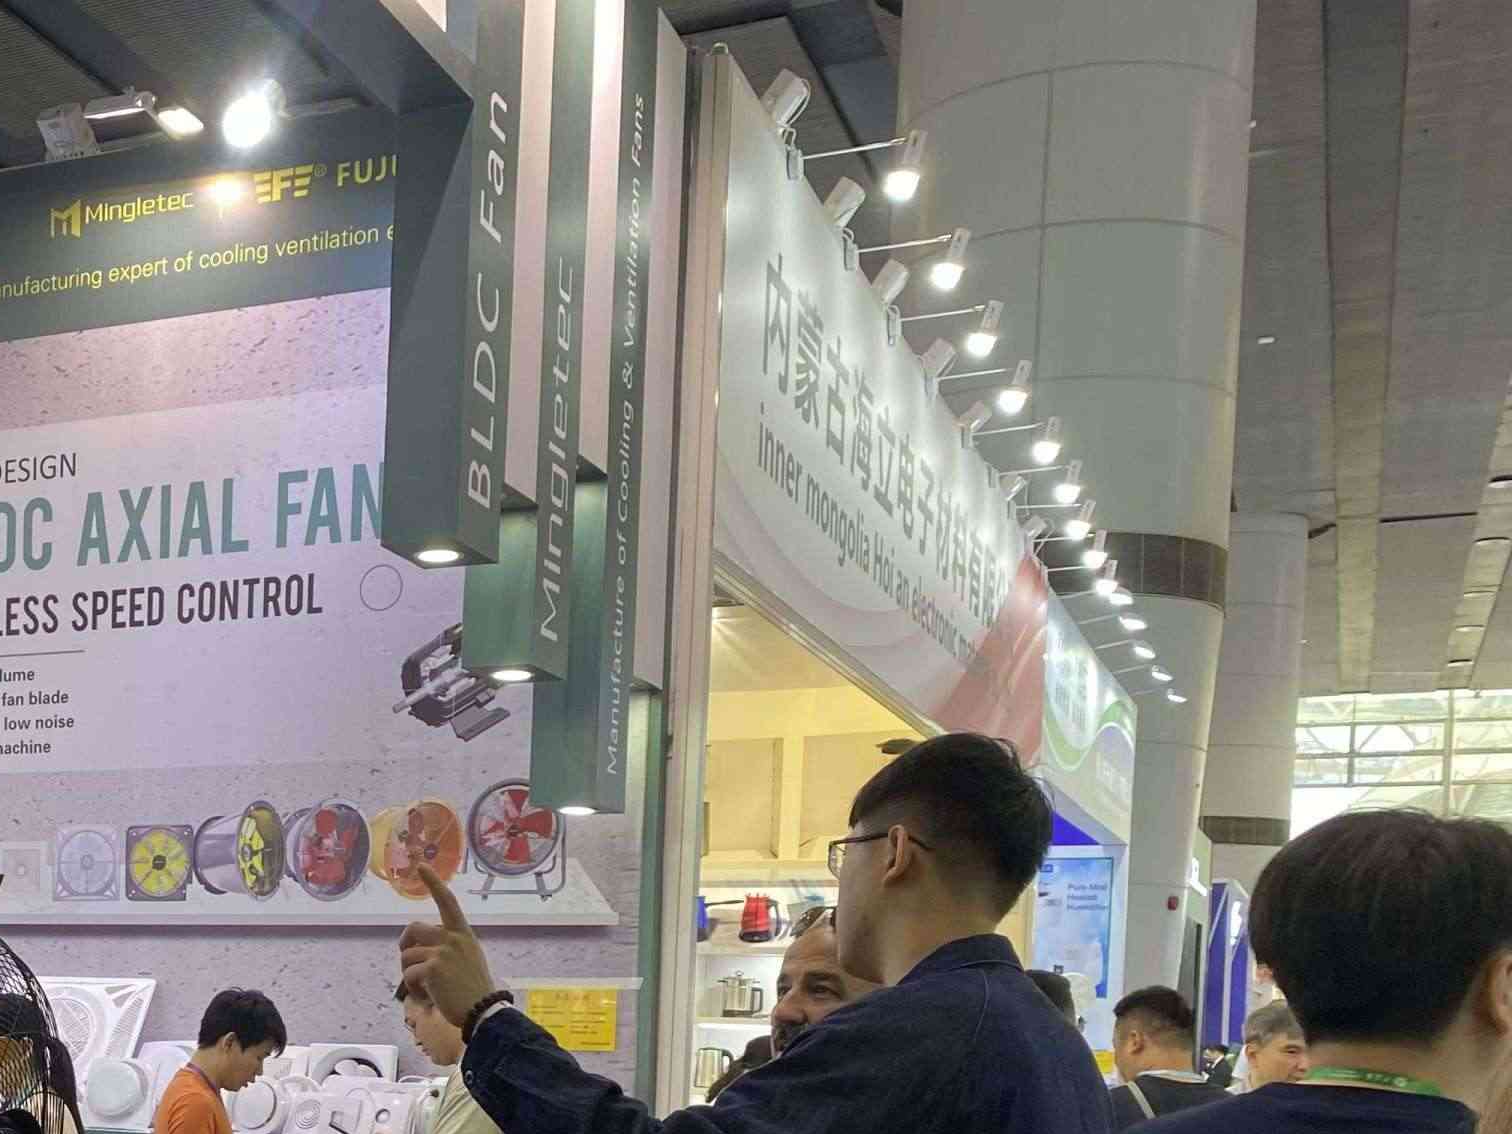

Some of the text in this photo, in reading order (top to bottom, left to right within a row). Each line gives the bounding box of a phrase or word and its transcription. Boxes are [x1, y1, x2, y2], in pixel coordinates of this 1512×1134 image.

[85, 191, 194, 224] Mingletec
[108, 258, 168, 283] expert
[174, 251, 194, 273] of
[199, 242, 268, 269] cooling
[275, 226, 379, 257] ventilation
[467, 90, 509, 510] BLDC Fan
[540, 256, 573, 642] Mingletec
[607, 94, 645, 775] Manufacture of Cooling & Ventilation Fans
[76, 478, 249, 566] AXIAL
[757, 402, 802, 505] inner
[805, 475, 870, 574] mongolia
[72, 585, 165, 631] SPEED
[177, 573, 323, 625] CONTROL
[1, 692, 24, 707] fan
[28, 690, 68, 706] blade
[4, 716, 31, 731] low
[35, 714, 74, 730] noise
